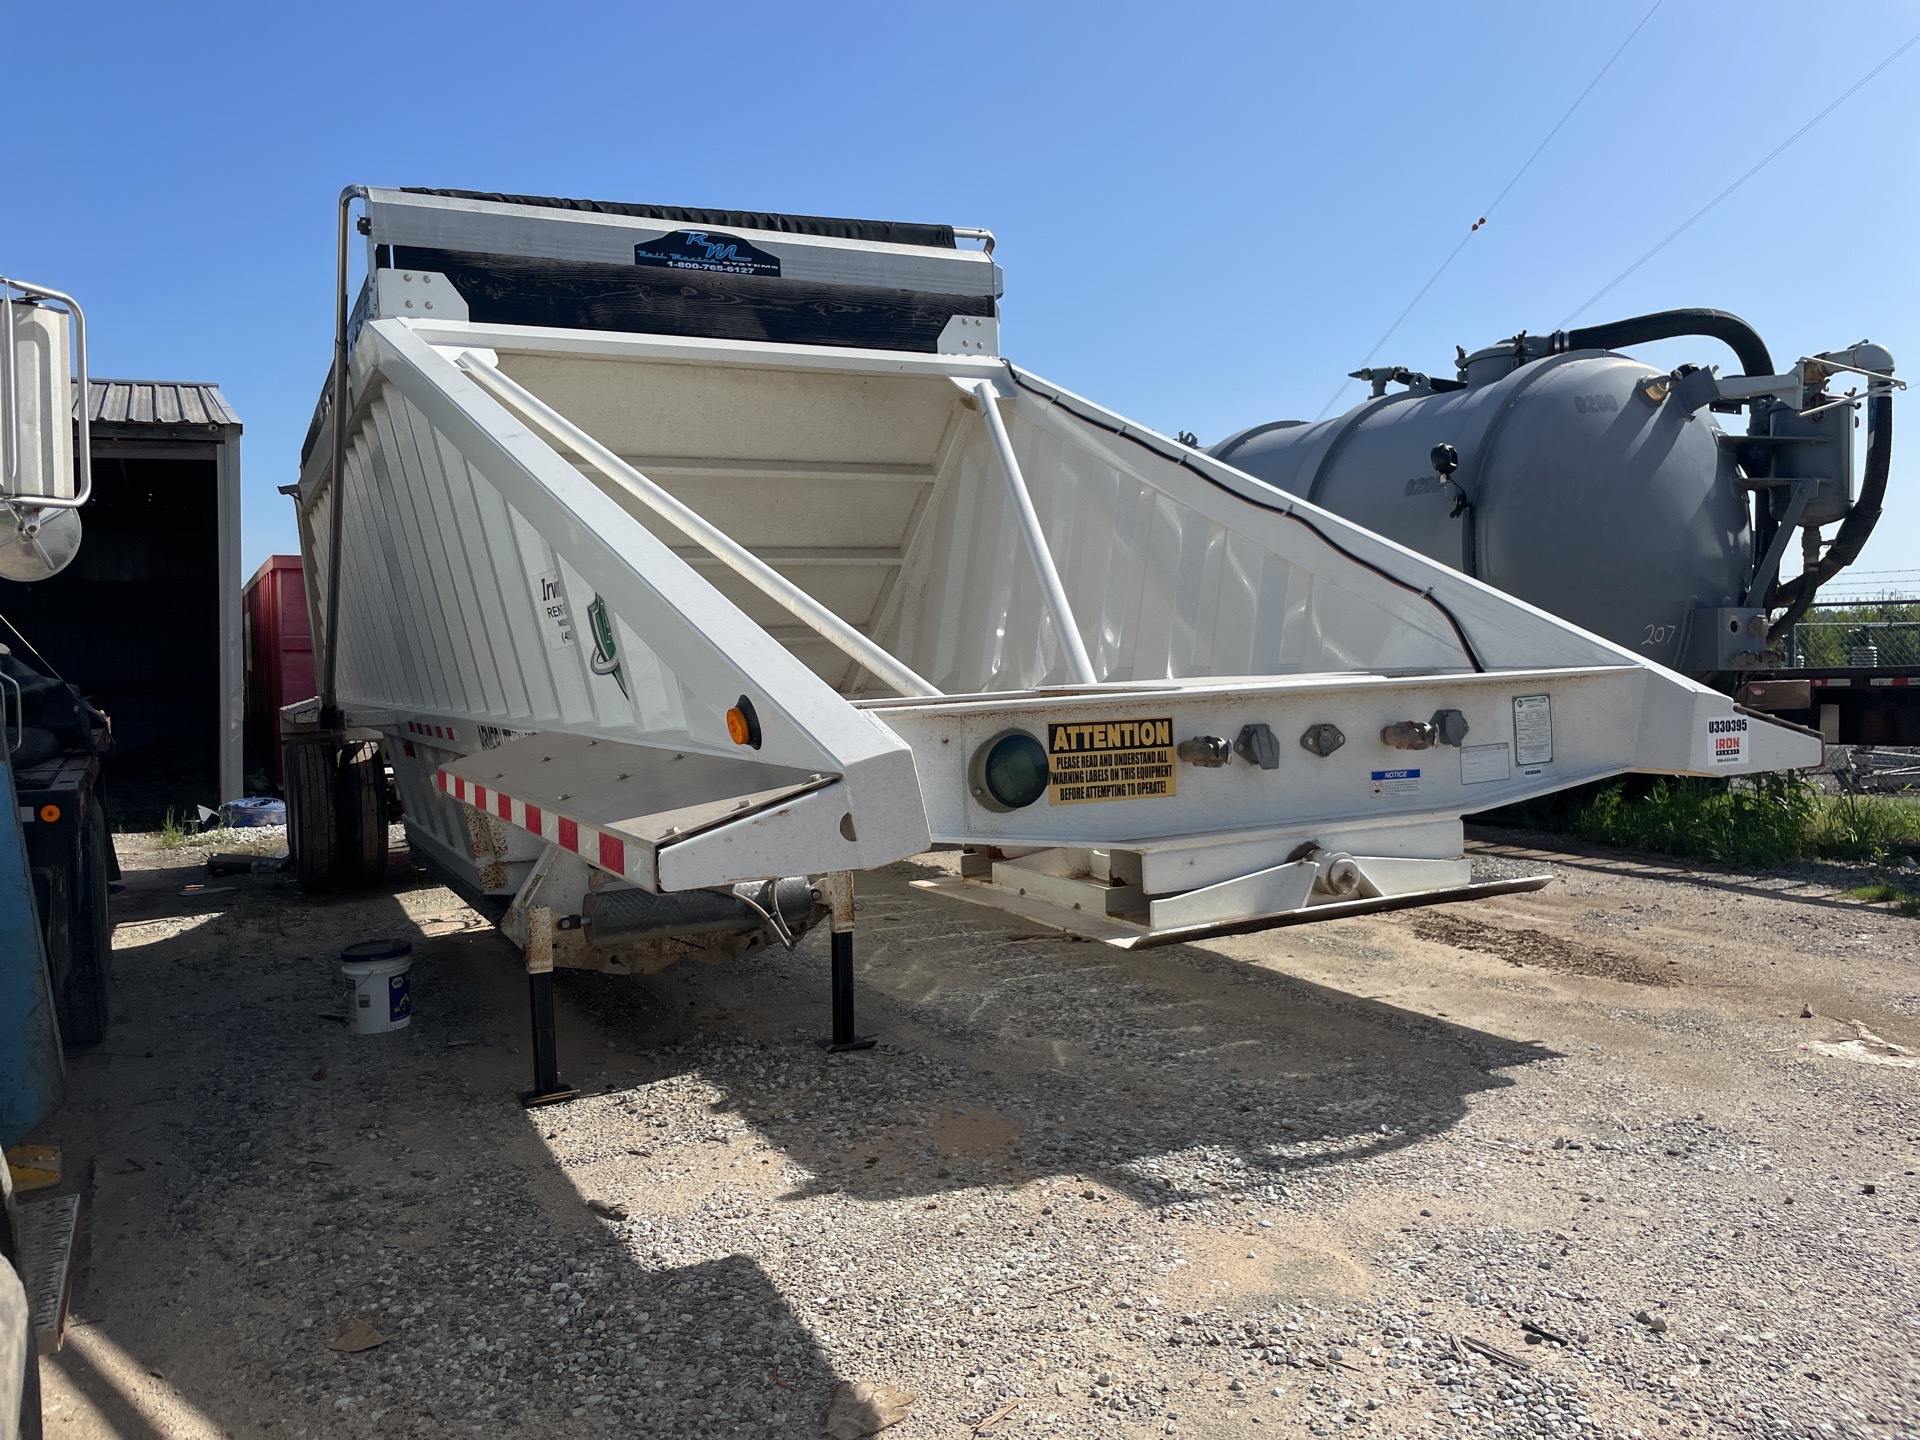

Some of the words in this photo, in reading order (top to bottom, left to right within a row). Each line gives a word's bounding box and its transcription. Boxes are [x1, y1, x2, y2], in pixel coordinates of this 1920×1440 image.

[667, 260, 755, 274] 1-800-765-6127
[1641, 623, 1676, 646] 207
[1053, 721, 1170, 751] ATTENTION
[1709, 719, 1747, 733] U330395
[1715, 737, 1740, 749] IRON
[1056, 755, 1080, 770] PLEASE
[1081, 754, 1098, 768] READ
[1099, 753, 1113, 767] AND
[1114, 751, 1156, 766] UNDERSTAND
[1157, 750, 1168, 763] ALL
[1052, 770, 1084, 785] WARNING
[1085, 768, 1109, 783] LABELS
[1110, 768, 1119, 781] ON
[1120, 766, 1136, 780] THIS
[1137, 764, 1173, 780] EQUIPMENT
[1384, 770, 1408, 779] NOTICE
[1060, 786, 1085, 801] BEFORE
[1085, 783, 1126, 799] ATTEMPTING
[1127, 782, 1136, 796] TO
[1137, 780, 1167, 796] OPERATE!
